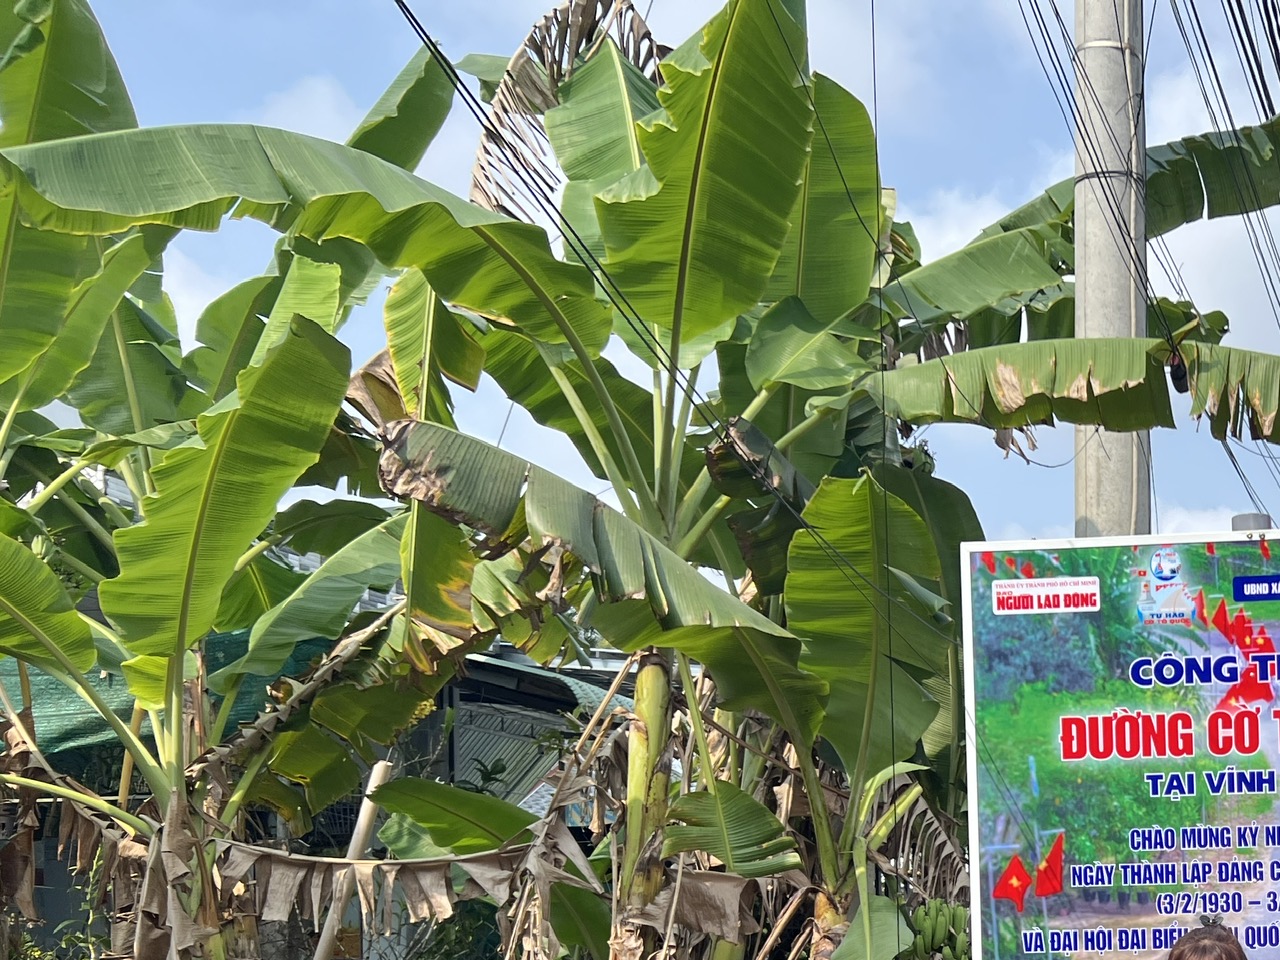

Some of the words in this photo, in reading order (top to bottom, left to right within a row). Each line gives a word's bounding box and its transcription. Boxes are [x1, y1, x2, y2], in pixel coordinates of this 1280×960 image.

[1025, 581, 1046, 589] THÀNH
[1046, 580, 1059, 588] PHỐ
[1243, 582, 1269, 596] UBND
[996, 593, 1034, 611] NGƯỜI
[1037, 594, 1061, 610] LAO
[1063, 591, 1097, 609] ĐỘNG
[1130, 652, 1239, 687] CÔNG
[1060, 708, 1194, 760] ĐƯỜNG
[1207, 704, 1261, 756] CỜ
[1145, 773, 1196, 799] TẠI
[1205, 767, 1276, 794] VĨNH
[1130, 826, 1176, 851] CHÀO
[1182, 824, 1231, 849] MỪNG
[1237, 821, 1259, 847] KỶ
[1071, 861, 1115, 887] NGÀY
[1120, 860, 1177, 885] THÀNH
[1182, 860, 1212, 887] LẬP
[1217, 856, 1264, 883] ĐẢNG
[1156, 892, 1243, 915] (3/2/1930
[1022, 926, 1045, 953] VÀ
[1050, 928, 1079, 956] ĐẠI
[1084, 926, 1113, 955] HỘI
[1118, 927, 1147, 955] ĐẠI
